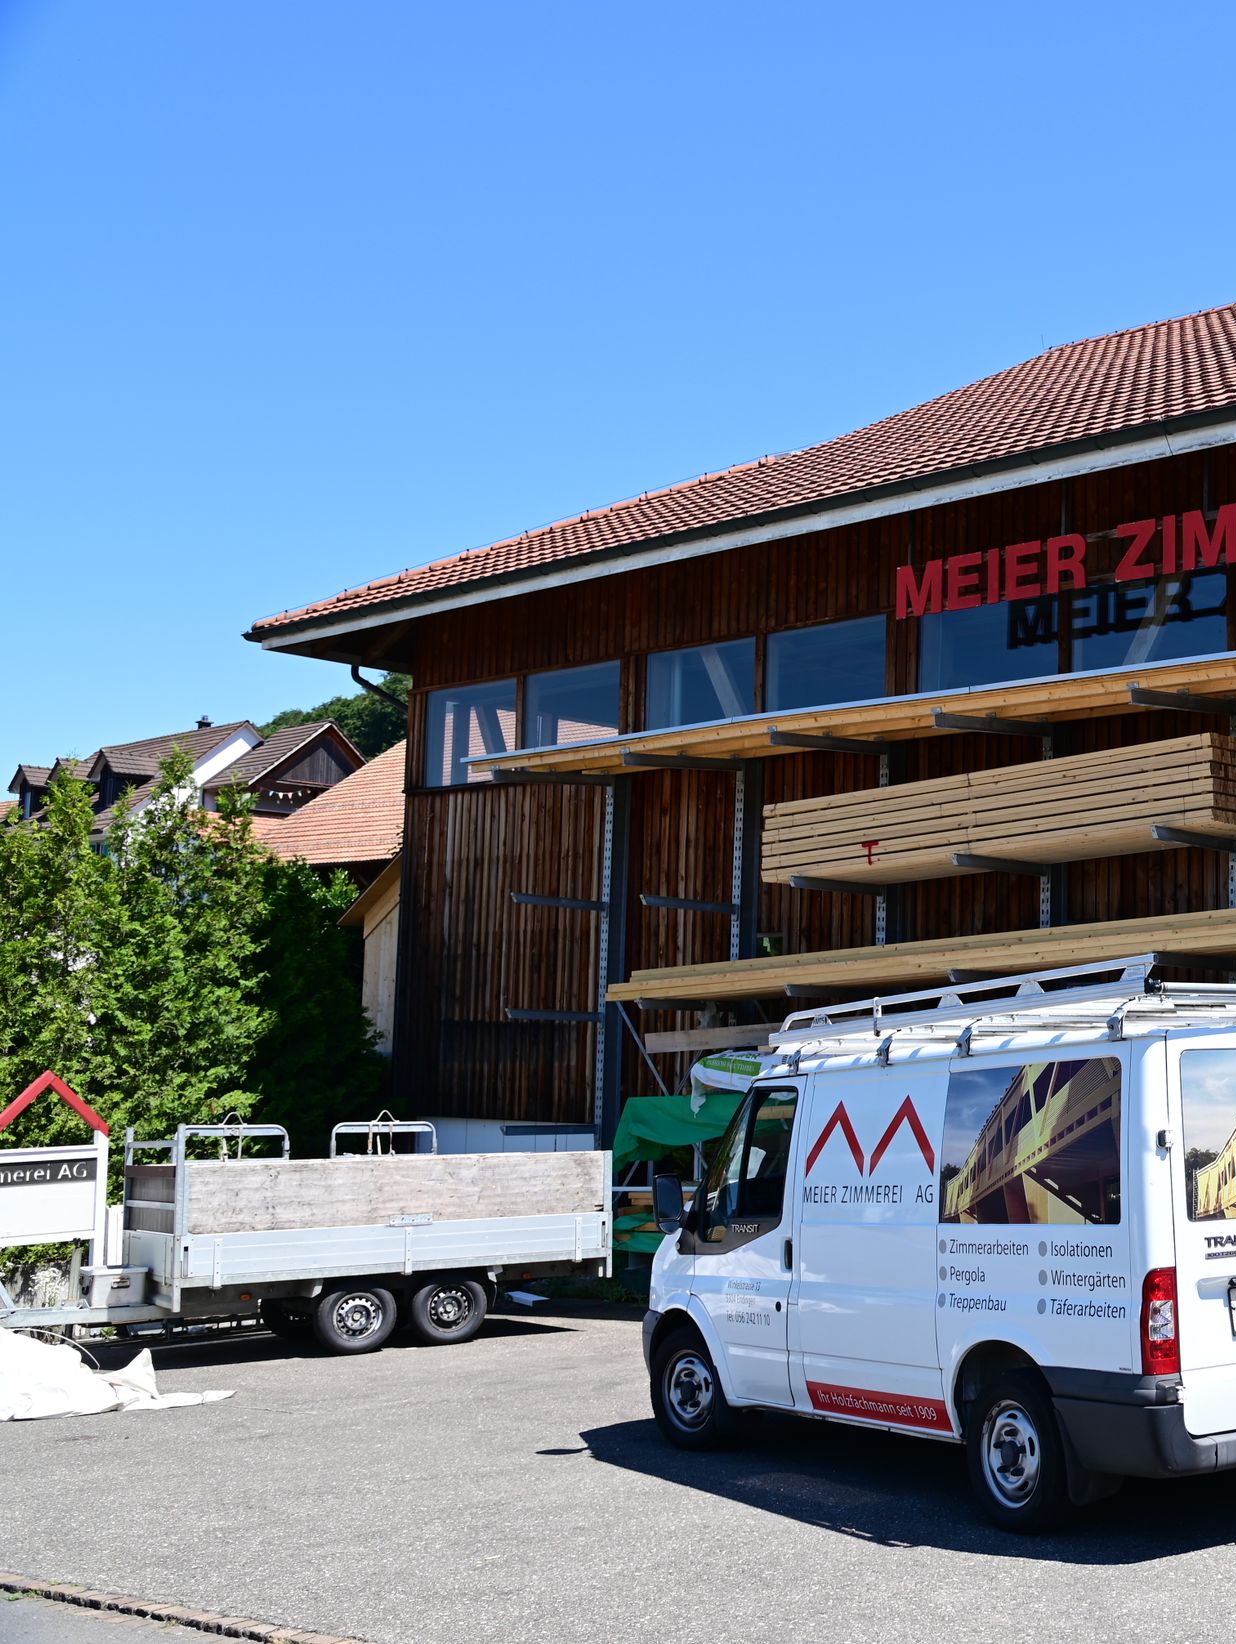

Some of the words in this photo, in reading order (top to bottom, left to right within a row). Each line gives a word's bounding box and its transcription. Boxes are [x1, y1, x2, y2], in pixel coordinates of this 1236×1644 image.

[896, 533, 1087, 619] MEIER
[57, 1161, 87, 1180] AG
[803, 1185, 837, 1204] MEIER
[840, 1184, 903, 1204] ZIMMEREI
[915, 1184, 934, 1204] AG
[731, 1223, 760, 1233] TRANSIT
[949, 1239, 1029, 1256] Zimmerarbeiten
[1050, 1240, 1113, 1258] Isolationen
[949, 1265, 986, 1285] Pergola
[1050, 1269, 1126, 1291] Wintergärten
[949, 1292, 1007, 1313] Treppenbau
[1050, 1298, 1126, 1319] Täferarbeiten
[816, 1389, 830, 1403] Ihr
[831, 1392, 897, 1416] Holzfachmann
[897, 1403, 914, 1418] seit
[914, 1405, 937, 1421] 1909
